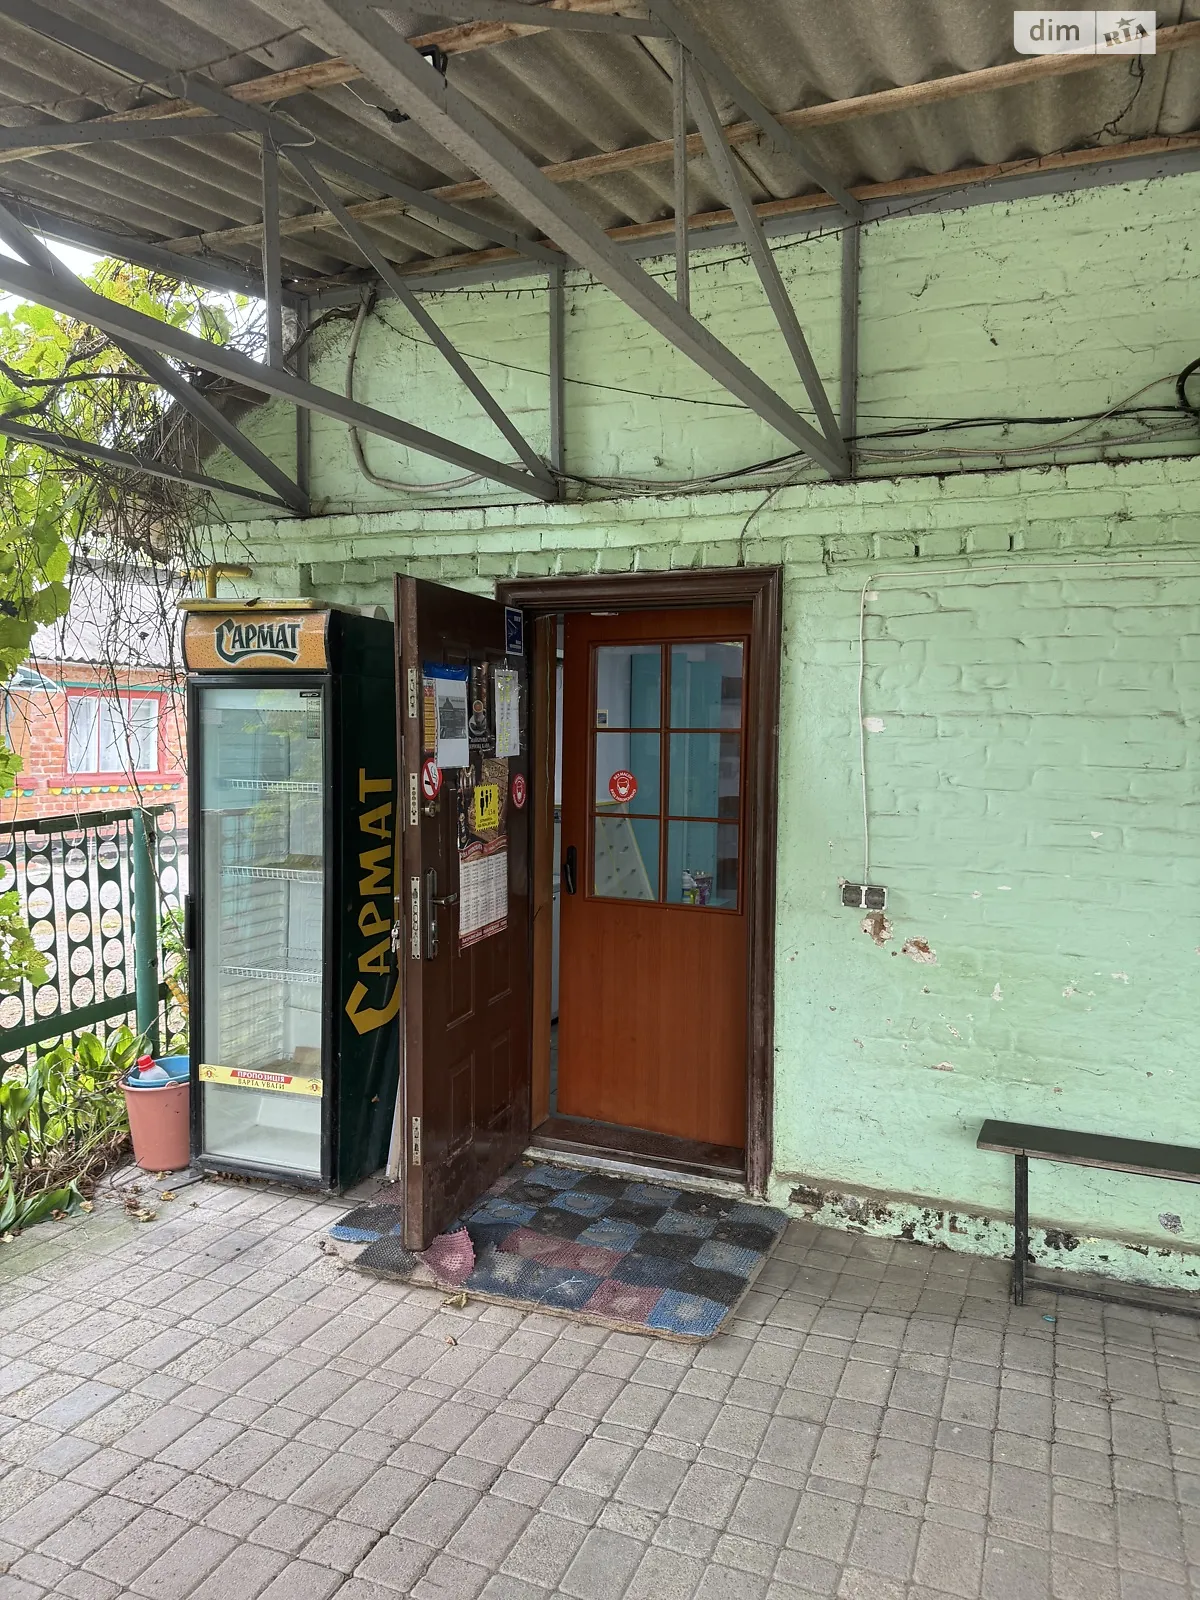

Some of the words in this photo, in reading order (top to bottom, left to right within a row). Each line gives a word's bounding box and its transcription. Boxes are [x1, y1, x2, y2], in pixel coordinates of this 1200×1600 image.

[215, 618, 301, 665] САРМАТ
[345, 767, 400, 1036] САРМАТ
[237, 1071, 285, 1083] ПРОПОЗИЦІЯ
[238, 1079, 260, 1087] ВАРТА
[261, 1081, 285, 1090] УВАГИ
